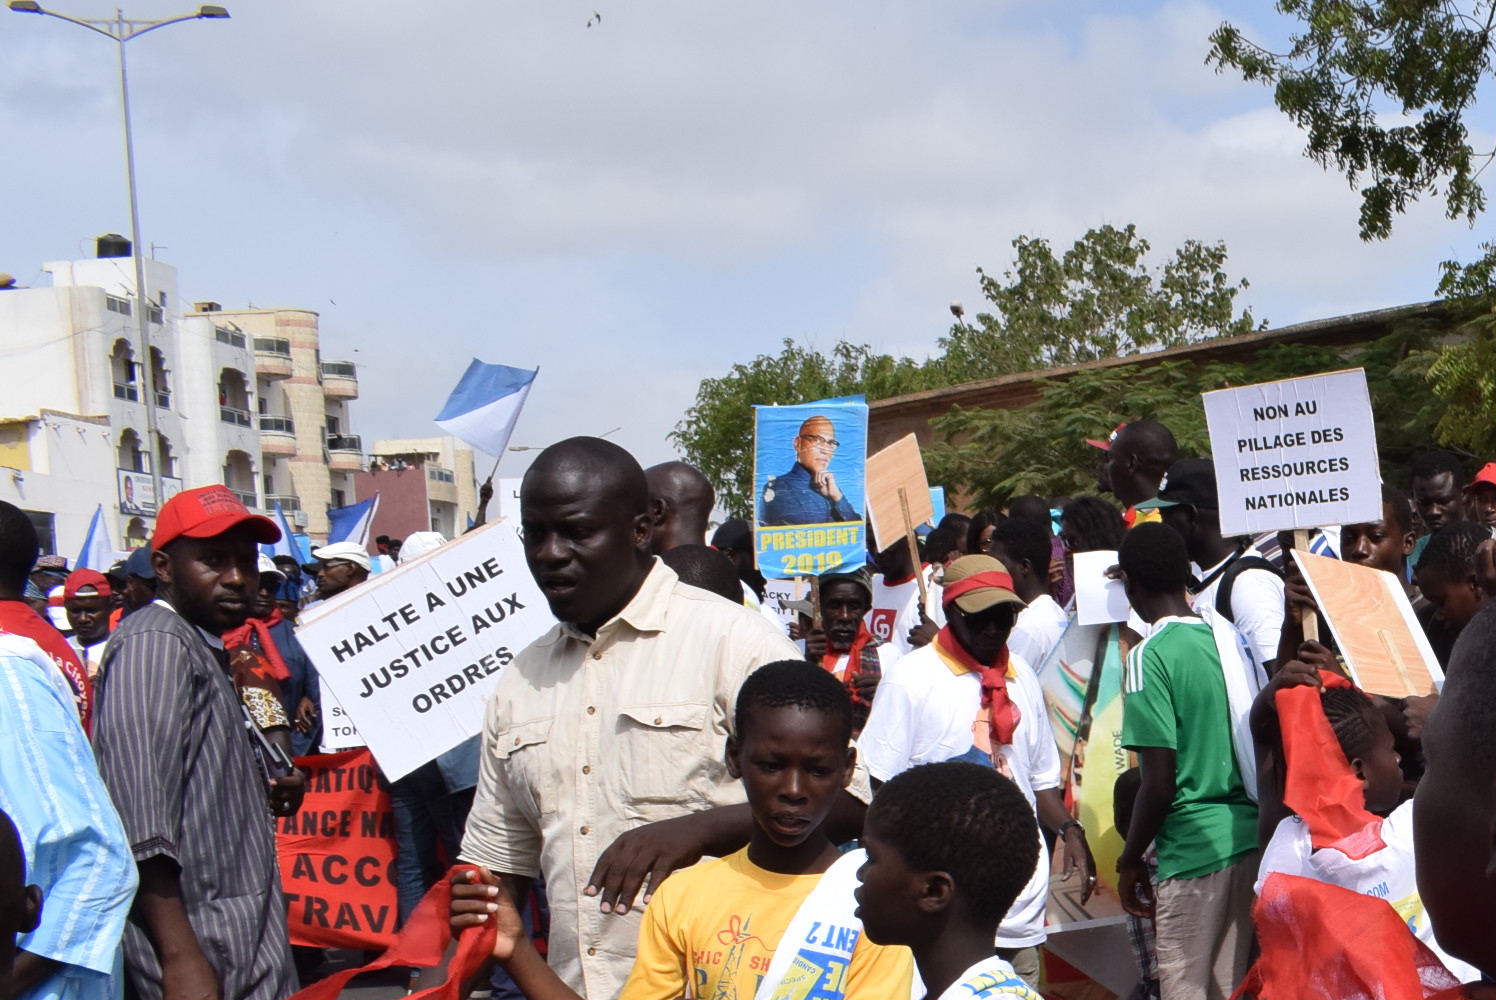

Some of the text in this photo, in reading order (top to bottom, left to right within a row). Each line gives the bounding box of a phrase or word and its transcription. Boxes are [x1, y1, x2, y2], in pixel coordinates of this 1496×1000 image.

[1253, 400, 1318, 421] NON AU
[1237, 427, 1344, 453] PILLAGE DES
[1239, 457, 1350, 482] RESSOURCES
[1245, 487, 1350, 511] NATIONALES
[760, 527, 859, 551] PRESIDENT
[781, 551, 843, 574] 2019
[330, 557, 504, 663] HALTE A UNE
[359, 592, 526, 698] JUSTICE AUX
[412, 646, 515, 714] ORDRES
